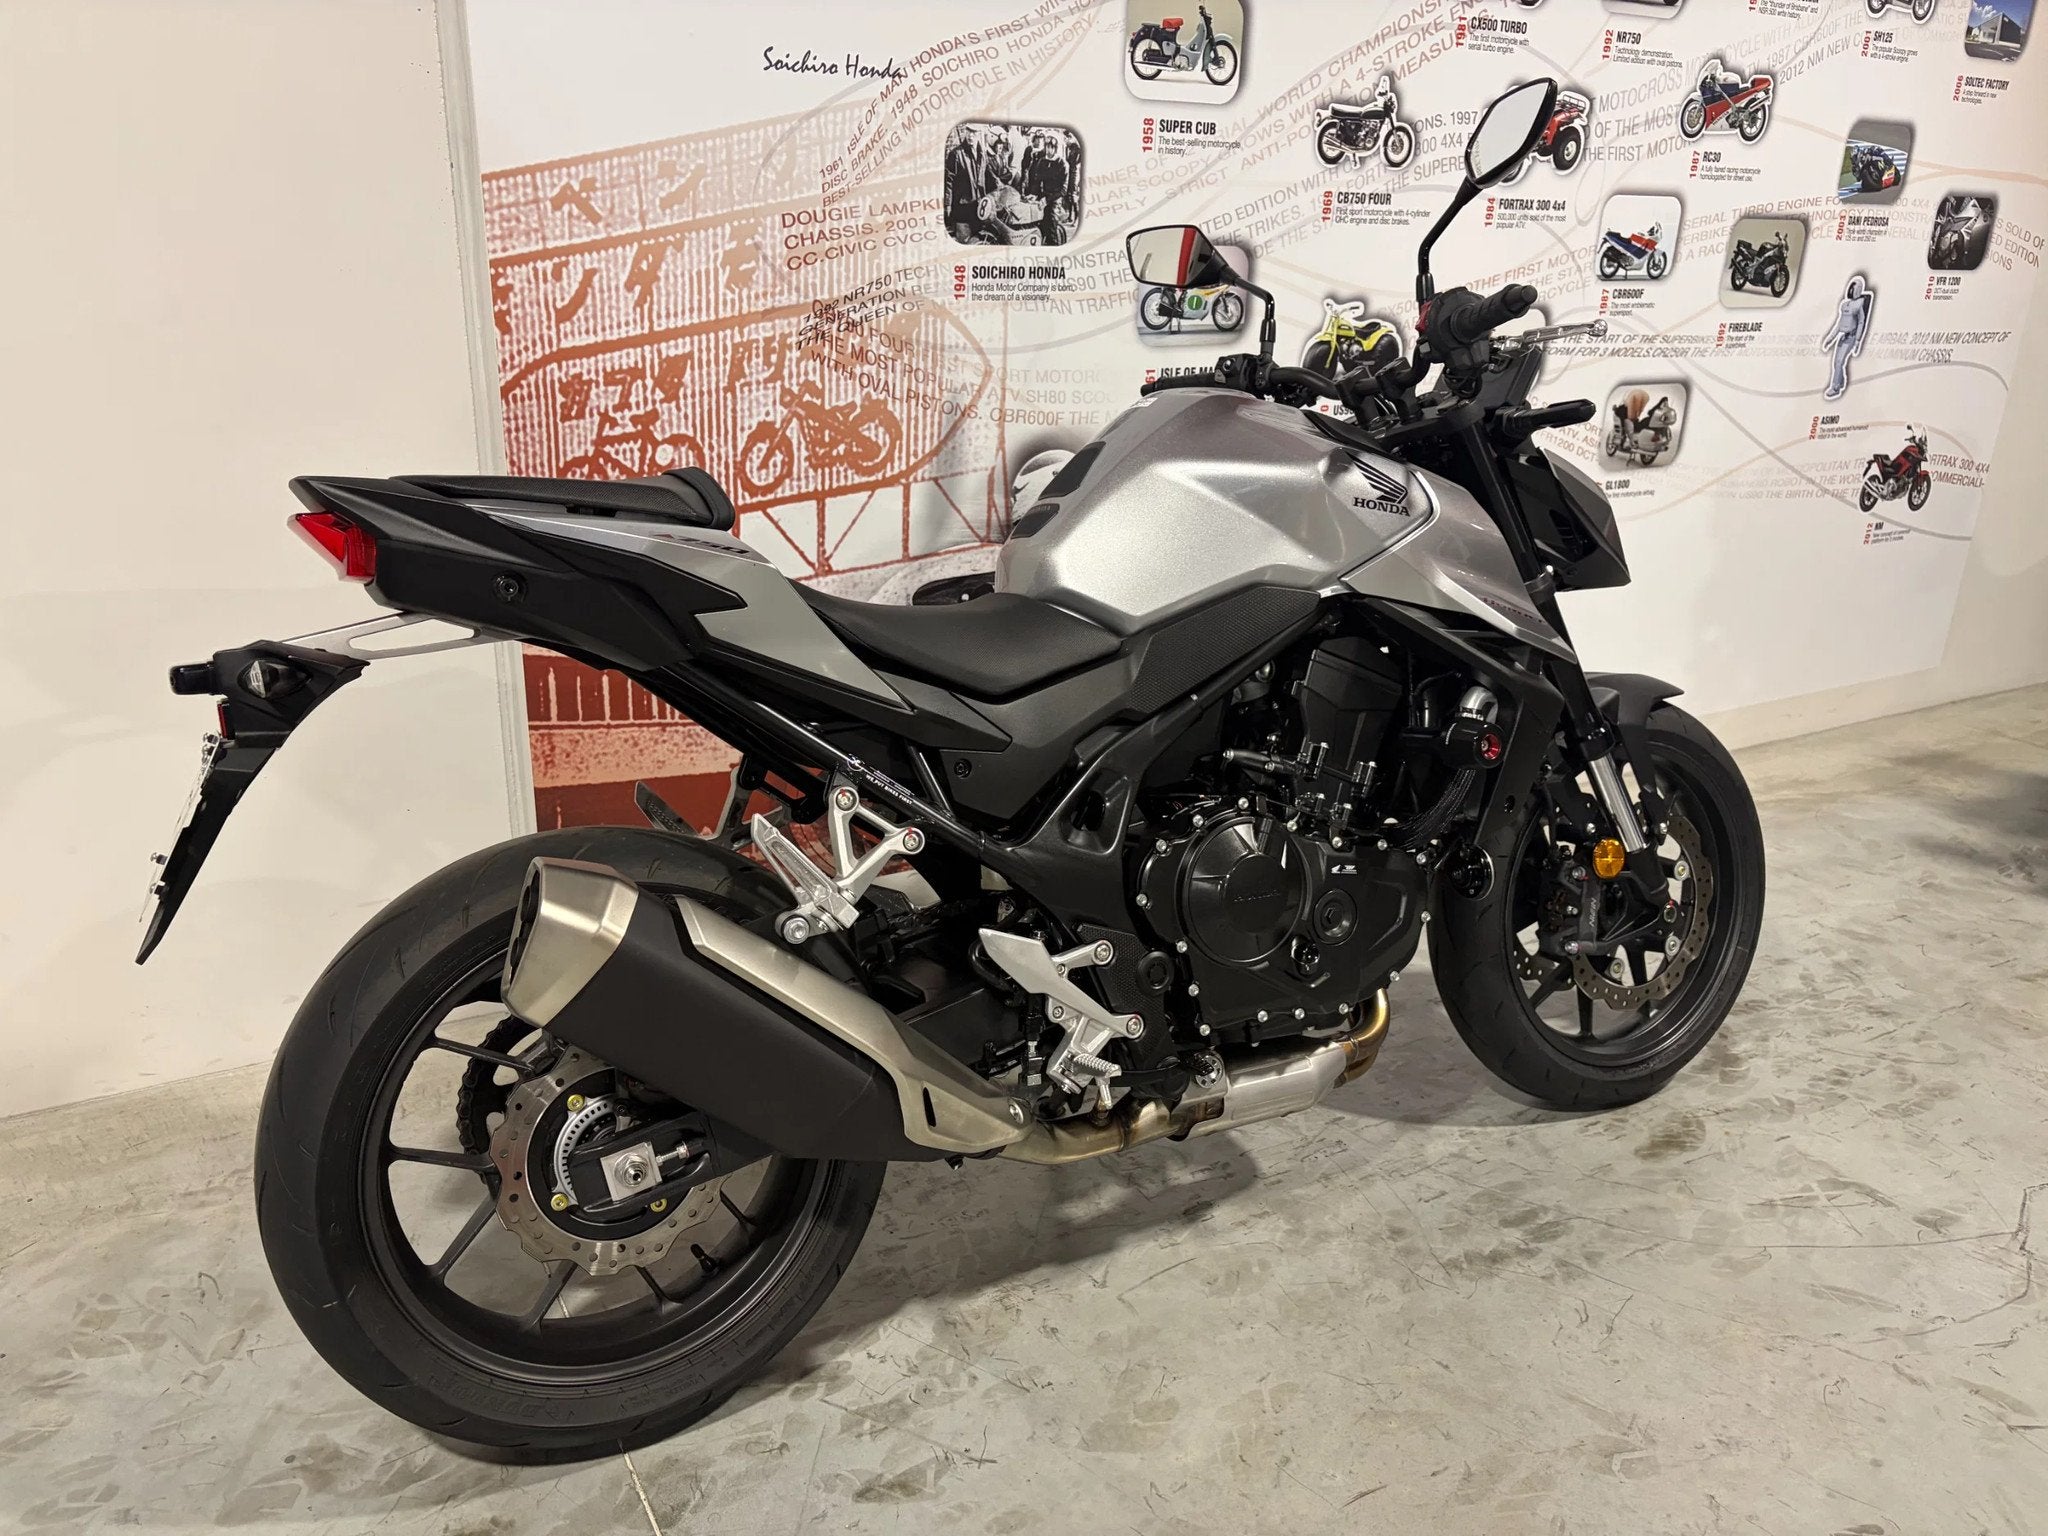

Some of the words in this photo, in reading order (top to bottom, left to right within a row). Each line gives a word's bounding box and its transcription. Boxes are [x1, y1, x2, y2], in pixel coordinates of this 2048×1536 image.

[1456, 16, 1467, 48] 1981
[1471, 17, 1498, 31] CX500
[1501, 20, 1527, 34] TURBO
[1616, 31, 1642, 44] NR750
[1873, 31, 1893, 43] SH125
[1468, 43, 1481, 51] serial
[1483, 44, 1496, 52] turbo
[1470, 33, 1479, 41] The
[1480, 34, 1489, 42] first
[1490, 36, 1518, 46] motorcycle
[1602, 29, 1613, 60] 1992
[1861, 30, 1872, 57] 2001
[763, 46, 838, 75] Soichiro
[845, 54, 902, 79] Honda
[1288, 87, 1334, 125] WITH
[1340, 78, 1351, 95] A
[1355, 14, 1446, 82] 4-STROKE
[1779, 60, 1804, 86] 2012
[1807, 50, 1824, 70] NM
[1827, 38, 1850, 58] NEW
[1258, 73, 1322, 117] WORLD
[1598, 69, 1682, 113] MOTOCROSS
[1953, 75, 1963, 101] 2006
[1964, 76, 1985, 88] SOLTEC
[1985, 79, 2009, 90] FACTORY
[819, 156, 843, 179] 1961
[847, 120, 867, 155] ISLE
[865, 99, 880, 126] OF
[880, 66, 909, 103] MAN
[910, 32, 981, 73] HONDA'S
[984, 14, 1032, 41] FIRST
[821, 169, 849, 193] DISC
[851, 127, 888, 172] BRAKE.
[891, 86, 919, 119] 1948
[922, 47, 1000, 87] SOICHIRO
[1006, 15, 1064, 53] HONDA
[822, 131, 902, 207] BEST-SELLING
[902, 67, 1007, 134] MOTORCYCLE
[1006, 58, 1028, 77] IN
[1028, 13, 1093, 66] HISTORY
[1142, 118, 1154, 152] 1958
[1159, 119, 1192, 134] SUPER
[1195, 121, 1217, 135] CUB
[1616, 114, 1641, 139] THE
[1159, 136, 1170, 145] The
[1171, 137, 1206, 149] best-selling
[1207, 139, 1240, 150] motorcycle
[1441, 132, 1463, 149] 4X4
[1235, 182, 1298, 220] EDITION
[1301, 165, 1339, 193] WITH
[1450, 111, 1478, 125] 1997
[1607, 145, 1643, 162] FIRST
[1689, 150, 1700, 178] 1987
[1703, 151, 1721, 163] RC30
[1085, 196, 1147, 219] APPLY
[1165, 167, 1229, 201] STRICT
[1337, 192, 1366, 205] CB750
[1368, 193, 1392, 206] FOUR
[1499, 198, 1534, 210] FORTRAX
[1536, 199, 1550, 211] 300
[1552, 200, 1566, 211] 4x4
[781, 205, 861, 229] DOUGIE
[869, 198, 944, 217] LAMPKI
[1321, 190, 1333, 222] 1969
[1336, 207, 1347, 215] First
[1349, 208, 1362, 217] sport
[1364, 208, 1392, 217] motorcycle
[1394, 209, 1404, 217] with
[1485, 197, 1495, 228] 1984
[1682, 211, 1727, 231] SERIAL
[1732, 203, 1773, 219] TURBO
[1777, 196, 1822, 212] ENGINE
[784, 223, 880, 250] CHASSIS.
[885, 216, 927, 233] 2001
[1350, 217, 1367, 226] engine
[1368, 217, 1378, 225] and
[1380, 217, 1390, 225] disc
[2005, 221, 2031, 242] SOLD
[787, 239, 877, 271] CC.CIVIC
[883, 230, 938, 248] CVCC
[954, 265, 967, 300] 1948
[972, 265, 1025, 280] SOICHIRO
[1029, 266, 1066, 280] HONDA
[1504, 261, 1543, 284] FIRST
[843, 274, 892, 307] NR750
[972, 283, 994, 292] Honda
[996, 283, 1016, 292] Motor
[1017, 283, 1049, 293] Company
[972, 293, 983, 301] the
[984, 293, 1006, 301] dream
[1007, 293, 1014, 301] of
[838, 304, 897, 333] QUEEN
[1728, 321, 1763, 333] FIREBLADE
[869, 327, 916, 357] FOUR
[1622, 334, 1639, 344] OF
[1638, 334, 1658, 344] THE
[1910, 332, 1931, 345] 2012
[1942, 331, 1962, 345] NEW
[1961, 330, 2000, 344] CONCEPT
[1998, 331, 2011, 343] OF
[851, 343, 898, 374] MOST
[1026, 389, 1067, 405] SH80
[812, 350, 853, 381] WITH
[858, 372, 902, 401] OVAL
[990, 407, 1064, 426] CBR600F
[1809, 415, 1819, 440] 2000
[1821, 415, 1840, 425] ASIMO
[1931, 470, 1985, 488] OMMERCIALI-
[1975, 462, 1991, 475] 4X4
[1353, 497, 1411, 517] HONDA
[884, 785, 899, 797] BIKES
[898, 793, 913, 805] FIRST
